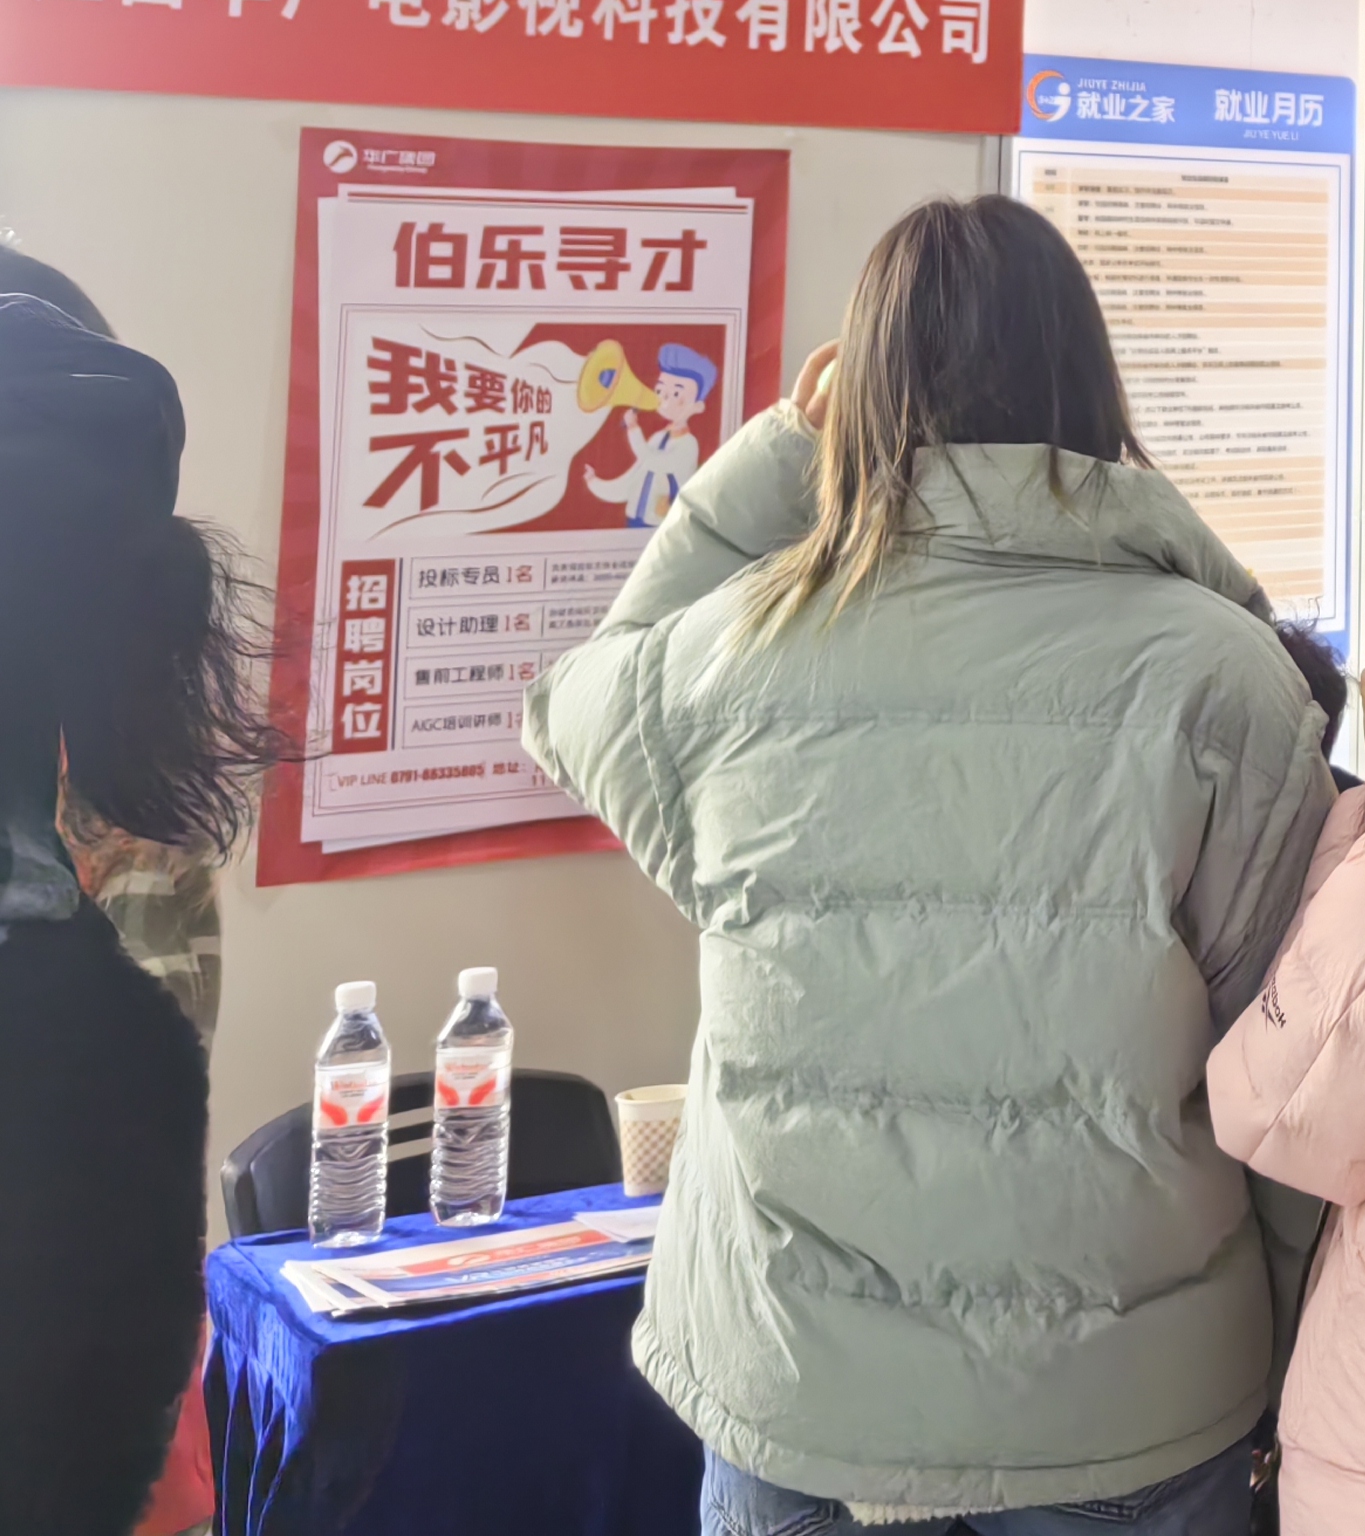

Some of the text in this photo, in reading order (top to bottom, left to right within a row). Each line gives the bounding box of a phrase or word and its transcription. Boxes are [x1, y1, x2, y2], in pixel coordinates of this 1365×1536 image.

[1076, 90, 1176, 124] 就业之家
[1214, 88, 1325, 127] 就业月历
[393, 221, 708, 293] 伯乐寻才
[366, 335, 553, 417] 我要你的
[362, 420, 549, 512] 不平凡
[417, 565, 500, 589] 投标专员
[416, 614, 499, 637] 设计助理
[340, 574, 388, 740] 招聘岗位
